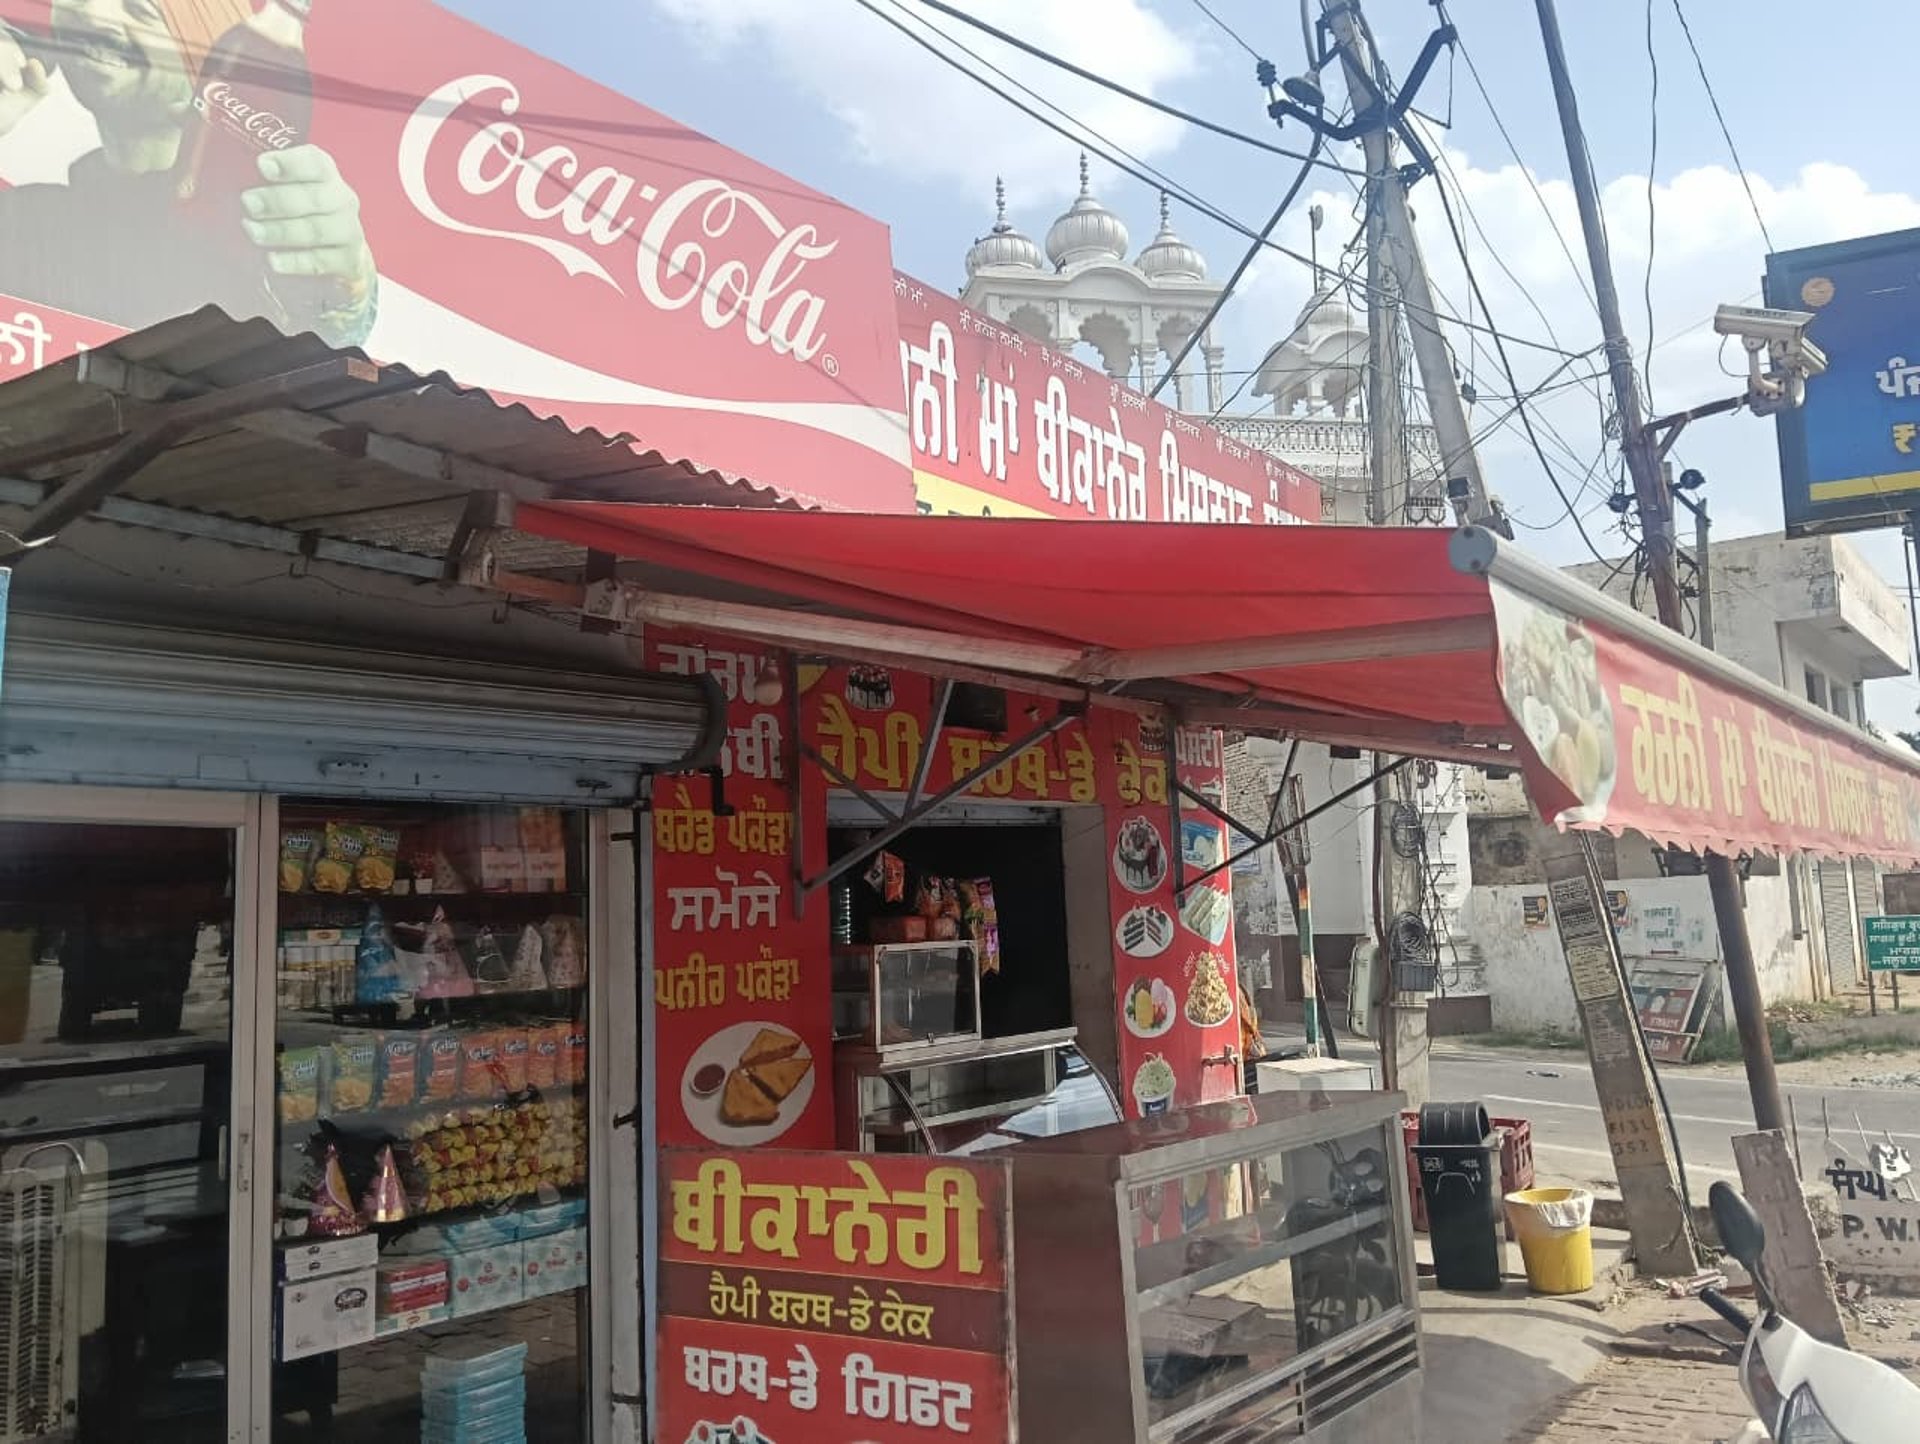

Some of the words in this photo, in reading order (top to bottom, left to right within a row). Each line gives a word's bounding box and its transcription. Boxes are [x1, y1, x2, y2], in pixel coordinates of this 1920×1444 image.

[400, 74, 839, 362] Coca-Cola
[667, 864, 781, 932] ਸਮੋਸੇ
[671, 1157, 985, 1275] ਬੀਕਾਨੇਰੀ
[1841, 1213, 1920, 1242] P.W.
[708, 1270, 762, 1320] ਹੈਪੀ
[767, 1285, 875, 1333] ਬਰਥ-ਡੇ
[879, 1288, 934, 1340] ਕੇਕ
[683, 1344, 820, 1411] ਬਰਥ-ਡੇ
[840, 1352, 974, 1434] ਗਿਫਟ
